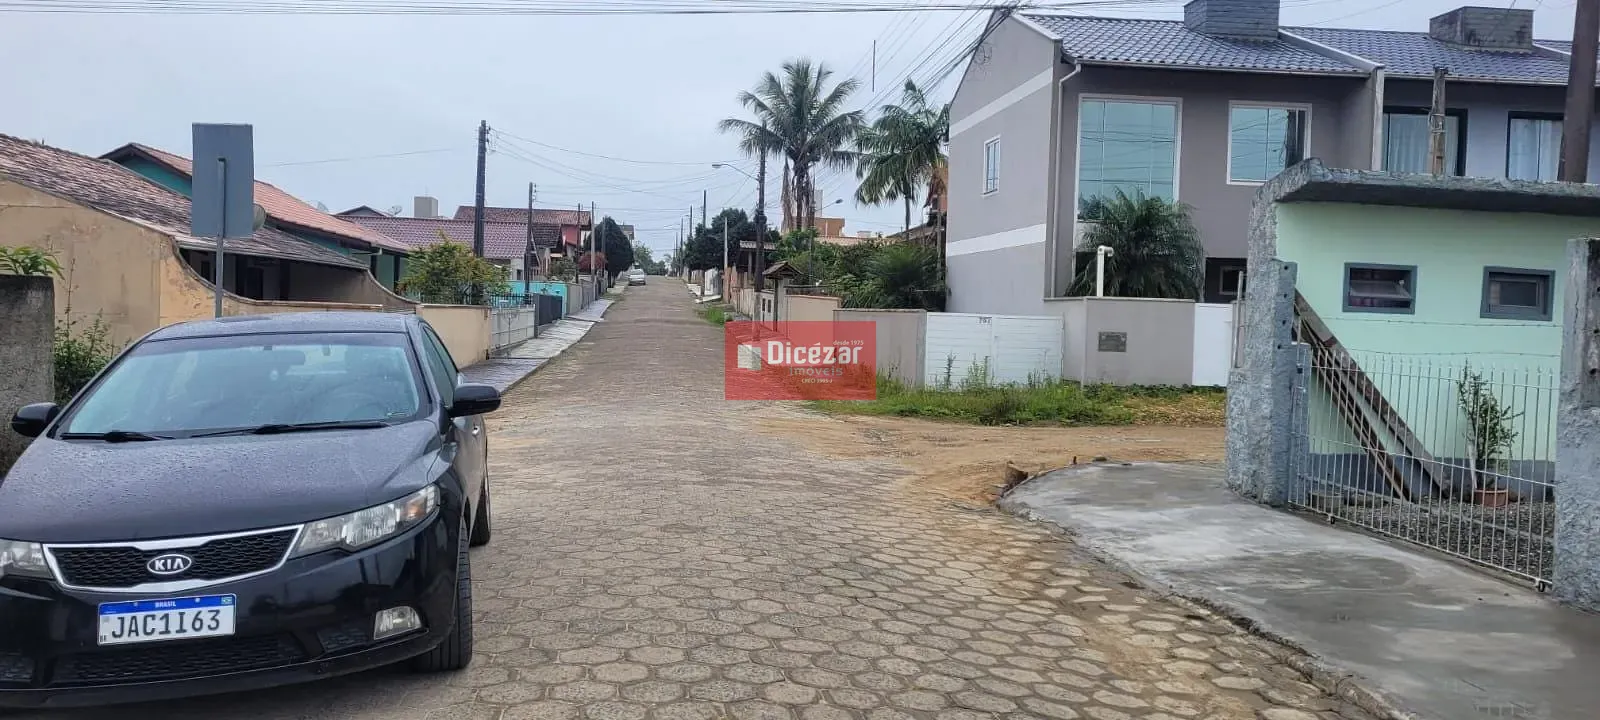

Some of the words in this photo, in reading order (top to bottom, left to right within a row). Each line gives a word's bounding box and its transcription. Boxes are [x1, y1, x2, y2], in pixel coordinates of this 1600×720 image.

[154, 558, 185, 571] KIA
[155, 600, 177, 608] BRASIL
[111, 609, 221, 639] JAC1I63
